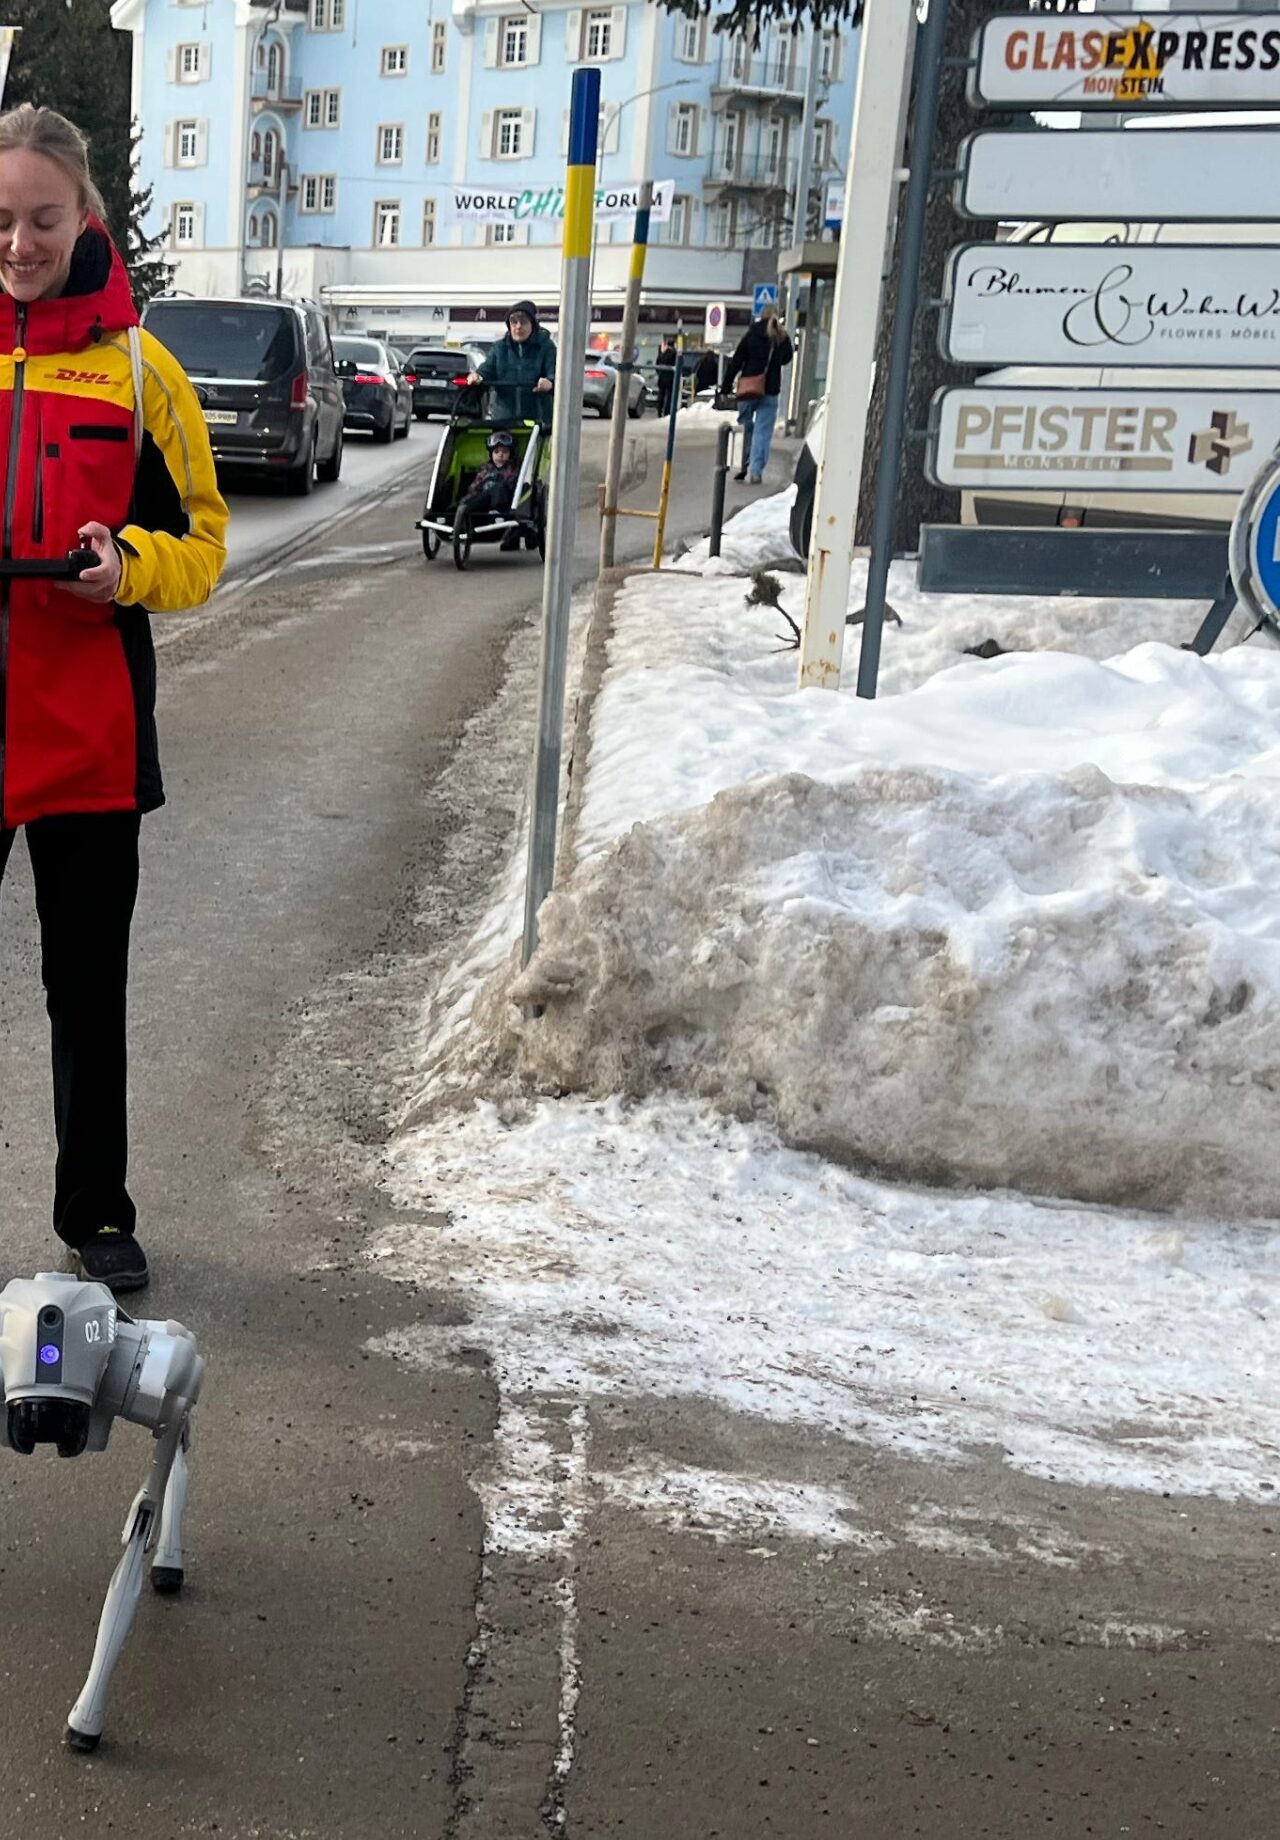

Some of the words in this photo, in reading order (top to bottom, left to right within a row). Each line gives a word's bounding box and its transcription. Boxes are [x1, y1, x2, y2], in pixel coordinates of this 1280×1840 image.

[1004, 29, 1280, 71] GLASEXPRESS
[1082, 76, 1164, 95] MONSTEIN
[455, 195, 520, 210] WORLD
[968, 266, 1089, 297] Blumen
[1062, 264, 1154, 347] &
[1160, 328, 1222, 339] FLOWERS
[55, 368, 111, 385] DHL
[955, 405, 1178, 452] PFISTER
[1003, 454, 1122, 471] MONSTEIN
[84, 1319, 101, 1343] 02
